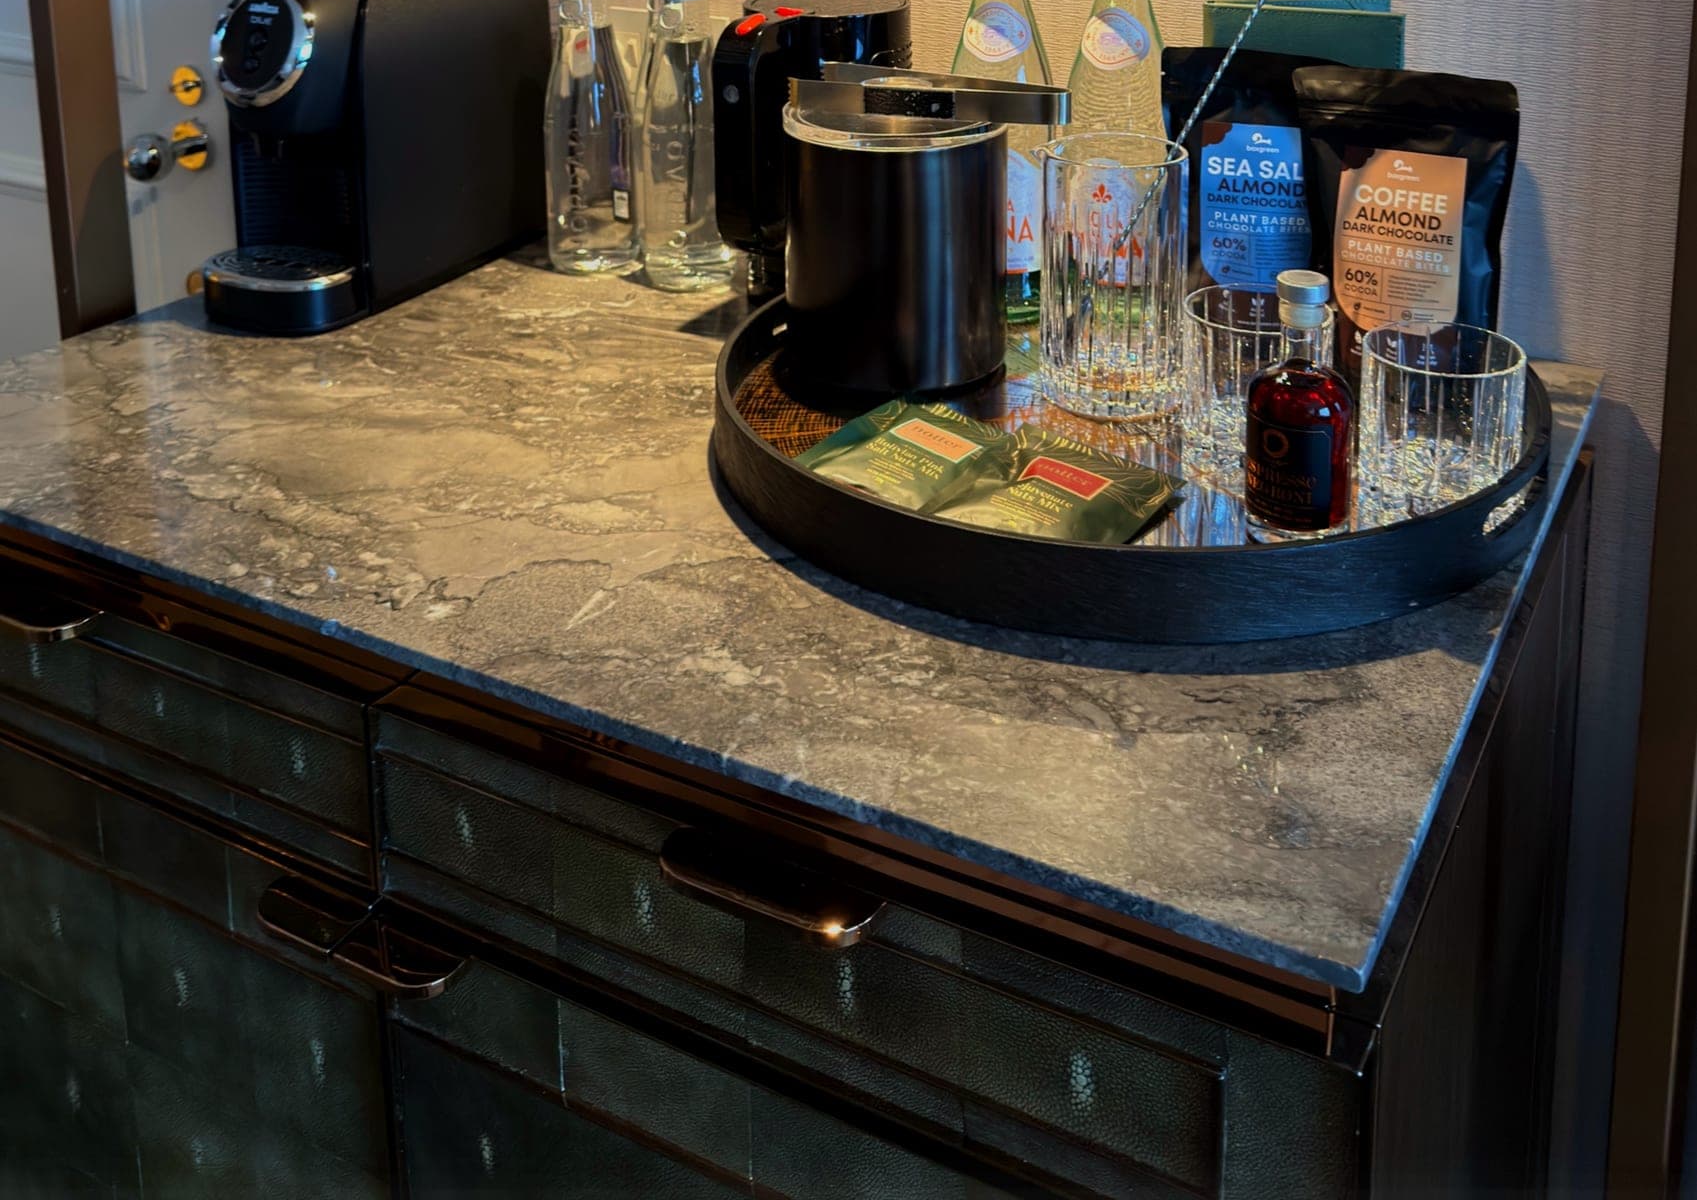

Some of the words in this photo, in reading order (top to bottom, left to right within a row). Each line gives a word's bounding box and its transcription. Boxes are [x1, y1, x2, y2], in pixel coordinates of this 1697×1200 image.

[1207, 156, 1254, 177] SEA
[1258, 160, 1304, 181] SAL
[1217, 178, 1305, 197] ALMOND
[1354, 184, 1449, 214] COFFEE
[1207, 193, 1239, 205] DARK
[1240, 196, 1305, 209] CHOCOLA
[1207, 220, 1275, 233] CHOCOLATE
[1214, 211, 1257, 225] PLANT
[1261, 216, 1306, 226] BASED
[1355, 206, 1442, 231] ALMOND
[1212, 237, 1247, 252] 60%
[1342, 220, 1375, 234] DARK
[1377, 225, 1454, 246] CHOCOLATE
[1340, 250, 1411, 269] CHOCOLATE
[1415, 261, 1450, 274] BITES
[1347, 240, 1392, 255] PLANT
[1396, 247, 1444, 263] BASED
[1344, 268, 1378, 287] 60%
[1344, 283, 1378, 297] COCOA
[865, 441, 890, 456] Salt
[892, 452, 916, 468] Nuts
[918, 465, 939, 480] Mix
[874, 436, 917, 460] Bolivian
[918, 456, 945, 475] Pink
[1008, 486, 1036, 502] Nuts
[1037, 497, 1060, 513] Mix
